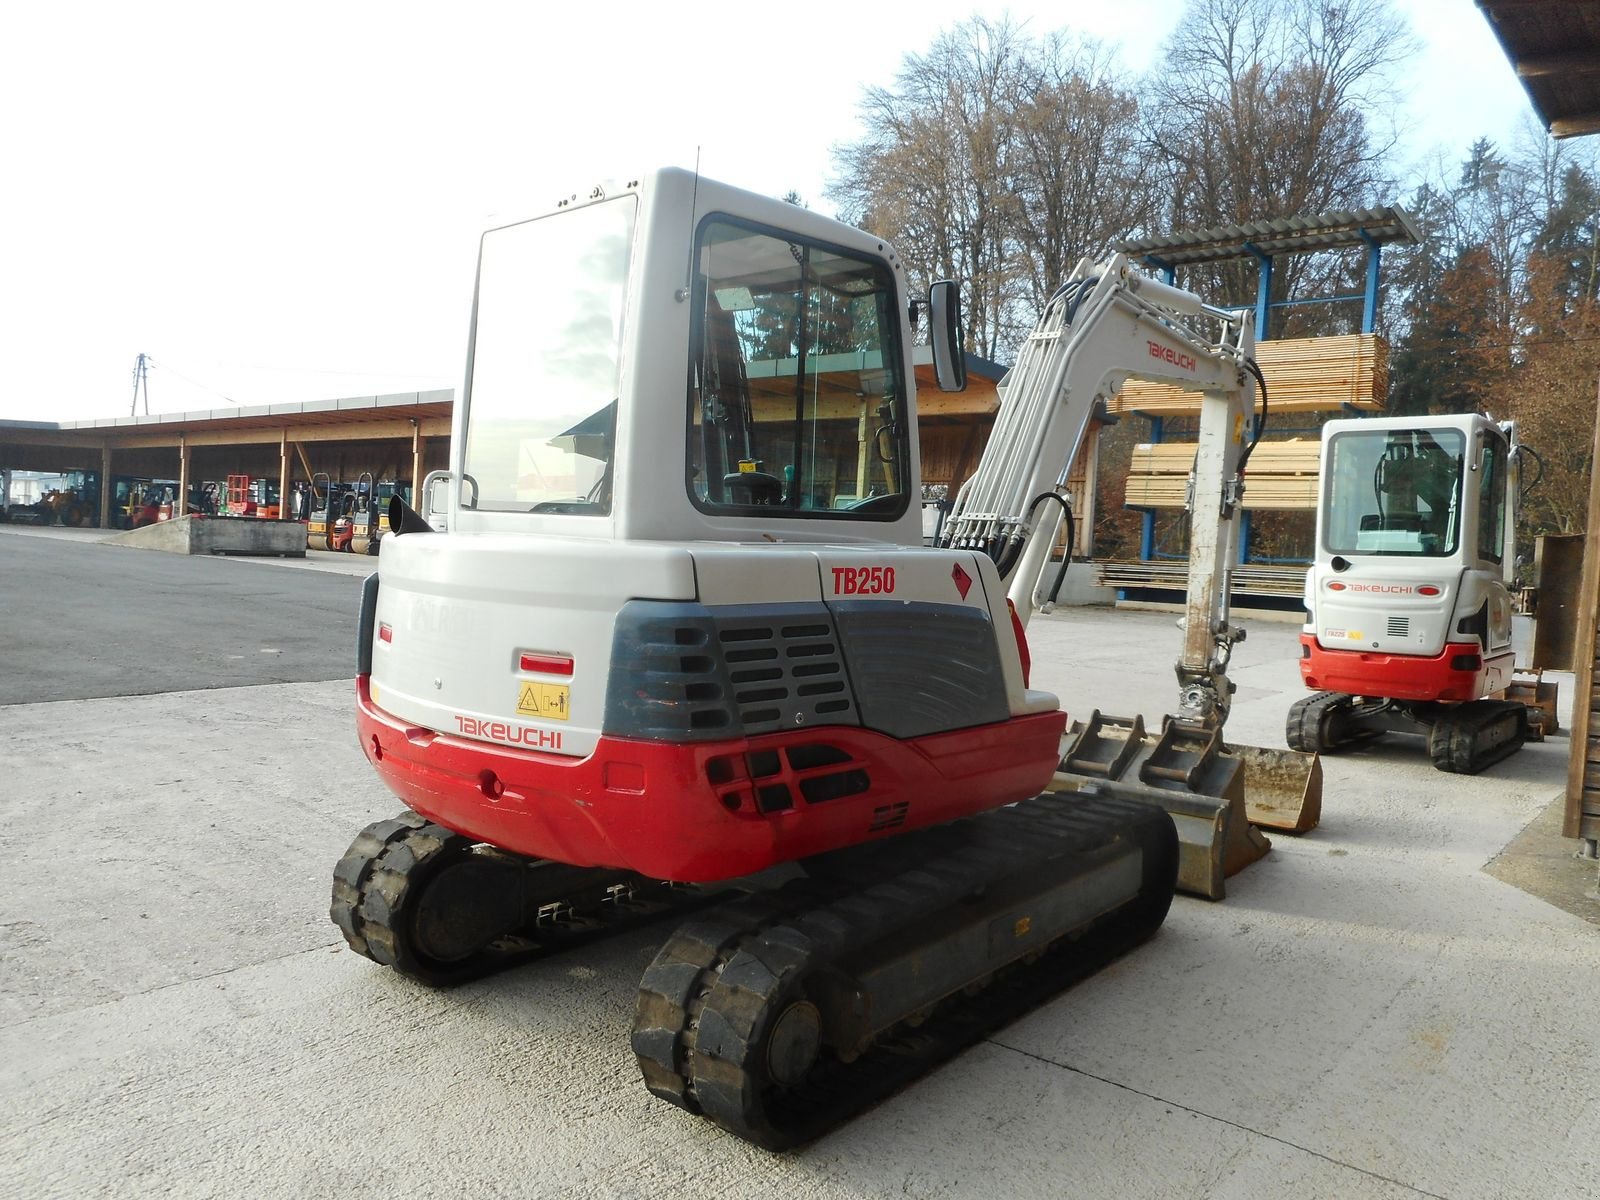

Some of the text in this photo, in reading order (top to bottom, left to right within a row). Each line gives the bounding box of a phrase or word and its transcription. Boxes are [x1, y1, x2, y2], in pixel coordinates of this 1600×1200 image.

[1146, 340, 1196, 373] TAKEUCHI
[831, 567, 895, 595] TB250
[1349, 583, 1413, 594] TAKEUCHI
[454, 715, 562, 749] TAKEUCHI
